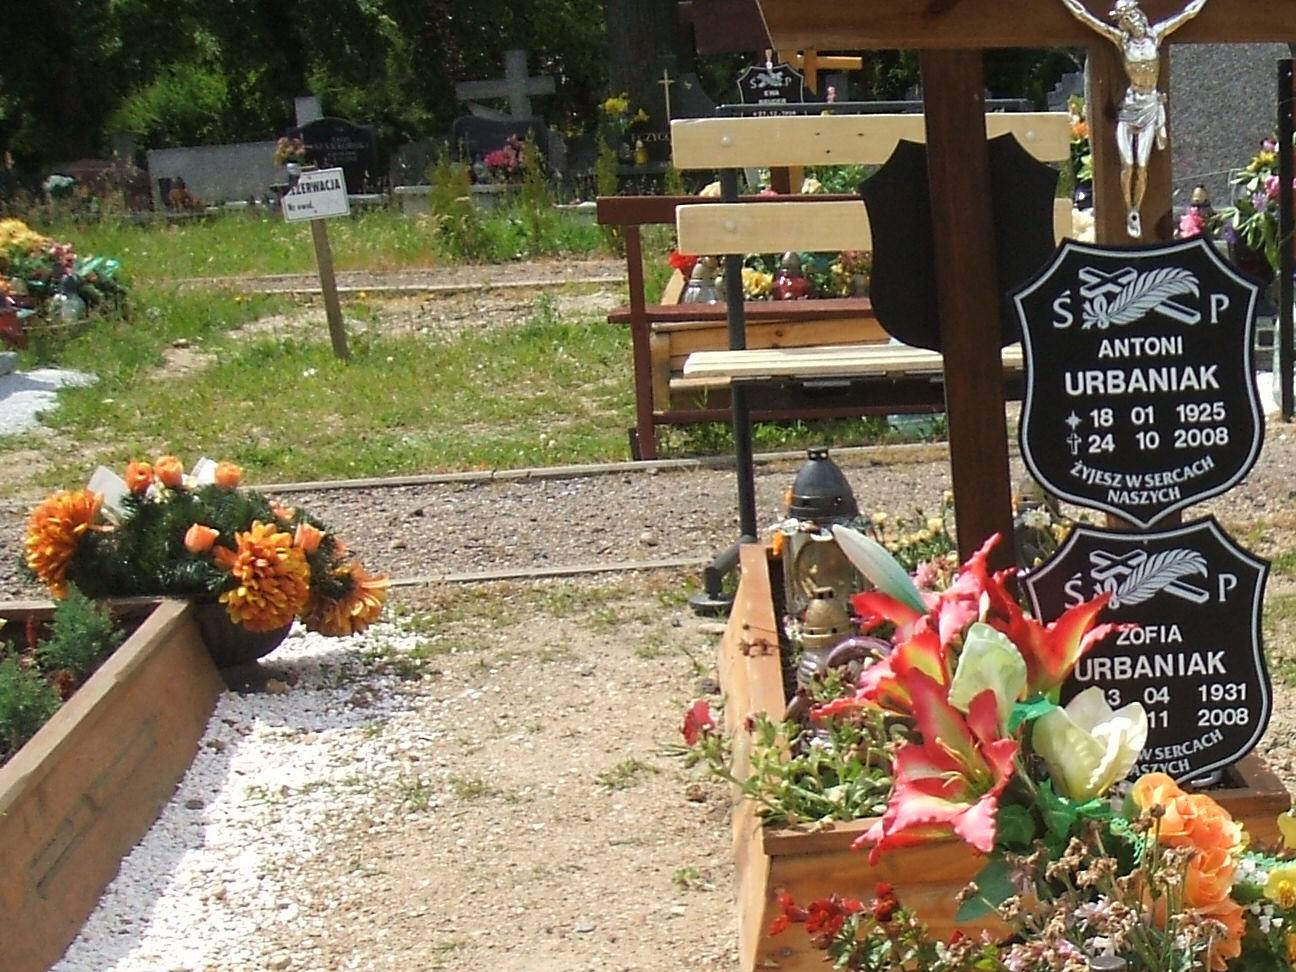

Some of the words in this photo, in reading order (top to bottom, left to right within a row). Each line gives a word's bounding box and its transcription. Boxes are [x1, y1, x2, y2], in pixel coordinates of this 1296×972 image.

[1053, 290, 1074, 329] Ś
[1210, 293, 1230, 324] P
[1098, 336, 1184, 359] ANTONI
[1065, 364, 1220, 396] URBANIAK
[1089, 408, 1114, 428] 18
[1131, 406, 1155, 425] 01
[1176, 401, 1226, 423] 1925
[1088, 433, 1116, 454] 24
[1136, 431, 1160, 450] 10
[1174, 427, 1229, 449] 2008
[1069, 459, 1123, 487] ŻYJESZ
[1125, 474, 1143, 488] W
[1145, 455, 1216, 487] SERCACH
[1107, 485, 1181, 504] NASZYCH
[1064, 572, 1085, 609] Ś
[1218, 573, 1238, 602] P
[1116, 624, 1183, 646] ZOFIA
[1074, 650, 1227, 682] URBANIAK
[1144, 686, 1171, 705] 04
[1198, 683, 1248, 702] 1931
[1149, 711, 1169, 730] 11
[1197, 708, 1249, 727] 2008
[1154, 728, 1224, 760] SERCACH
[1130, 758, 1191, 777] ASZYCH
